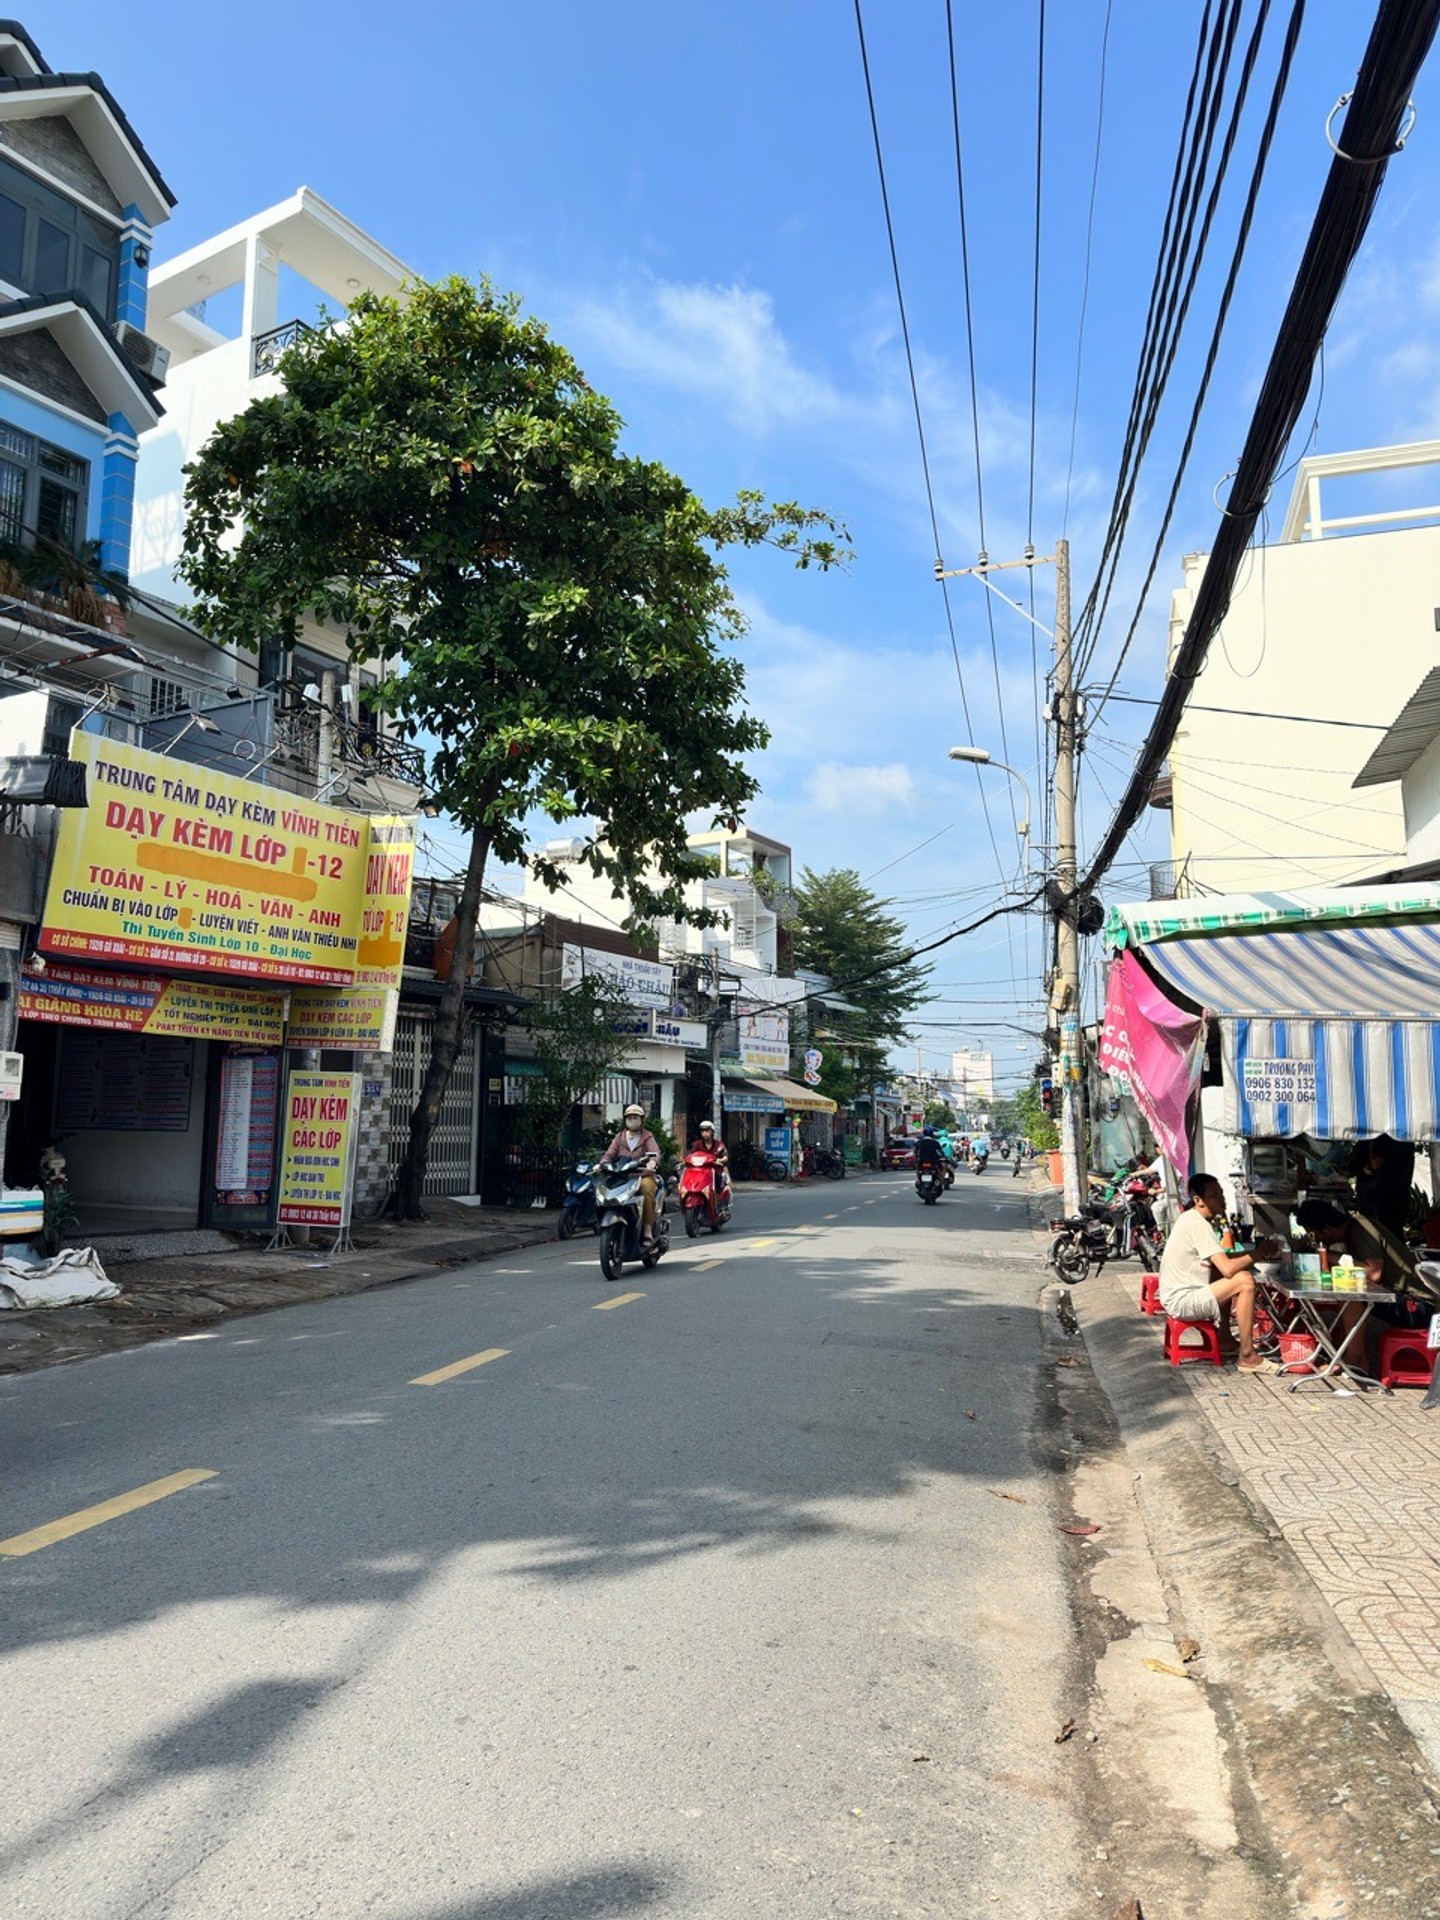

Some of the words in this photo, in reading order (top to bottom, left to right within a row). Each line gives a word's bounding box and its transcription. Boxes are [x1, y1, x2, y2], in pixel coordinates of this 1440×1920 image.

[95, 760, 156, 794] TRUNG
[162, 779, 200, 806] TÂM
[205, 792, 238, 817] DẠY
[242, 800, 276, 826] KÈM
[281, 808, 320, 837] VĨNH
[105, 800, 165, 839] DẠY
[172, 818, 233, 854] KÈM
[240, 834, 287, 865] LỚP
[89, 865, 144, 892] TOÁN
[164, 880, 187, 899] LÝ
[206, 888, 242, 910] HOÁ
[260, 898, 294, 919] VĂN
[308, 908, 342, 928] ANH
[63, 888, 109, 910] CHUẨN
[112, 900, 125, 917] BỊ
[128, 900, 152, 917] VÀO
[155, 904, 179, 921] LỚP
[200, 913, 234, 933] LUYỆN
[237, 918, 259, 935] VIẾT
[268, 925, 290, 940] ANH
[292, 930, 310, 944] VĂN
[313, 931, 339, 948] THIẾU
[122, 921, 142, 935] Thi
[148, 925, 184, 944] Tuyển
[188, 931, 220, 947] Sinh
[220, 937, 241, 951] Lớp
[245, 941, 259, 953] 10
[269, 944, 288, 958] Đại
[291, 948, 312, 960] Học
[18, 996, 31, 1008] AI
[36, 997, 80, 1015] GIẢNG
[199, 1000, 212, 1010] THI
[1245, 1077, 1271, 1089] 0906
[1274, 1077, 1294, 1089] 830
[1297, 1078, 1315, 1089] 132
[1246, 1090, 1272, 1101] 0902
[1274, 1090, 1294, 1102] 300
[1297, 1090, 1316, 1102] 064
[292, 1096, 317, 1124] DẠY
[292, 1126, 316, 1147] CÁC
[320, 1127, 342, 1149] LỚP
